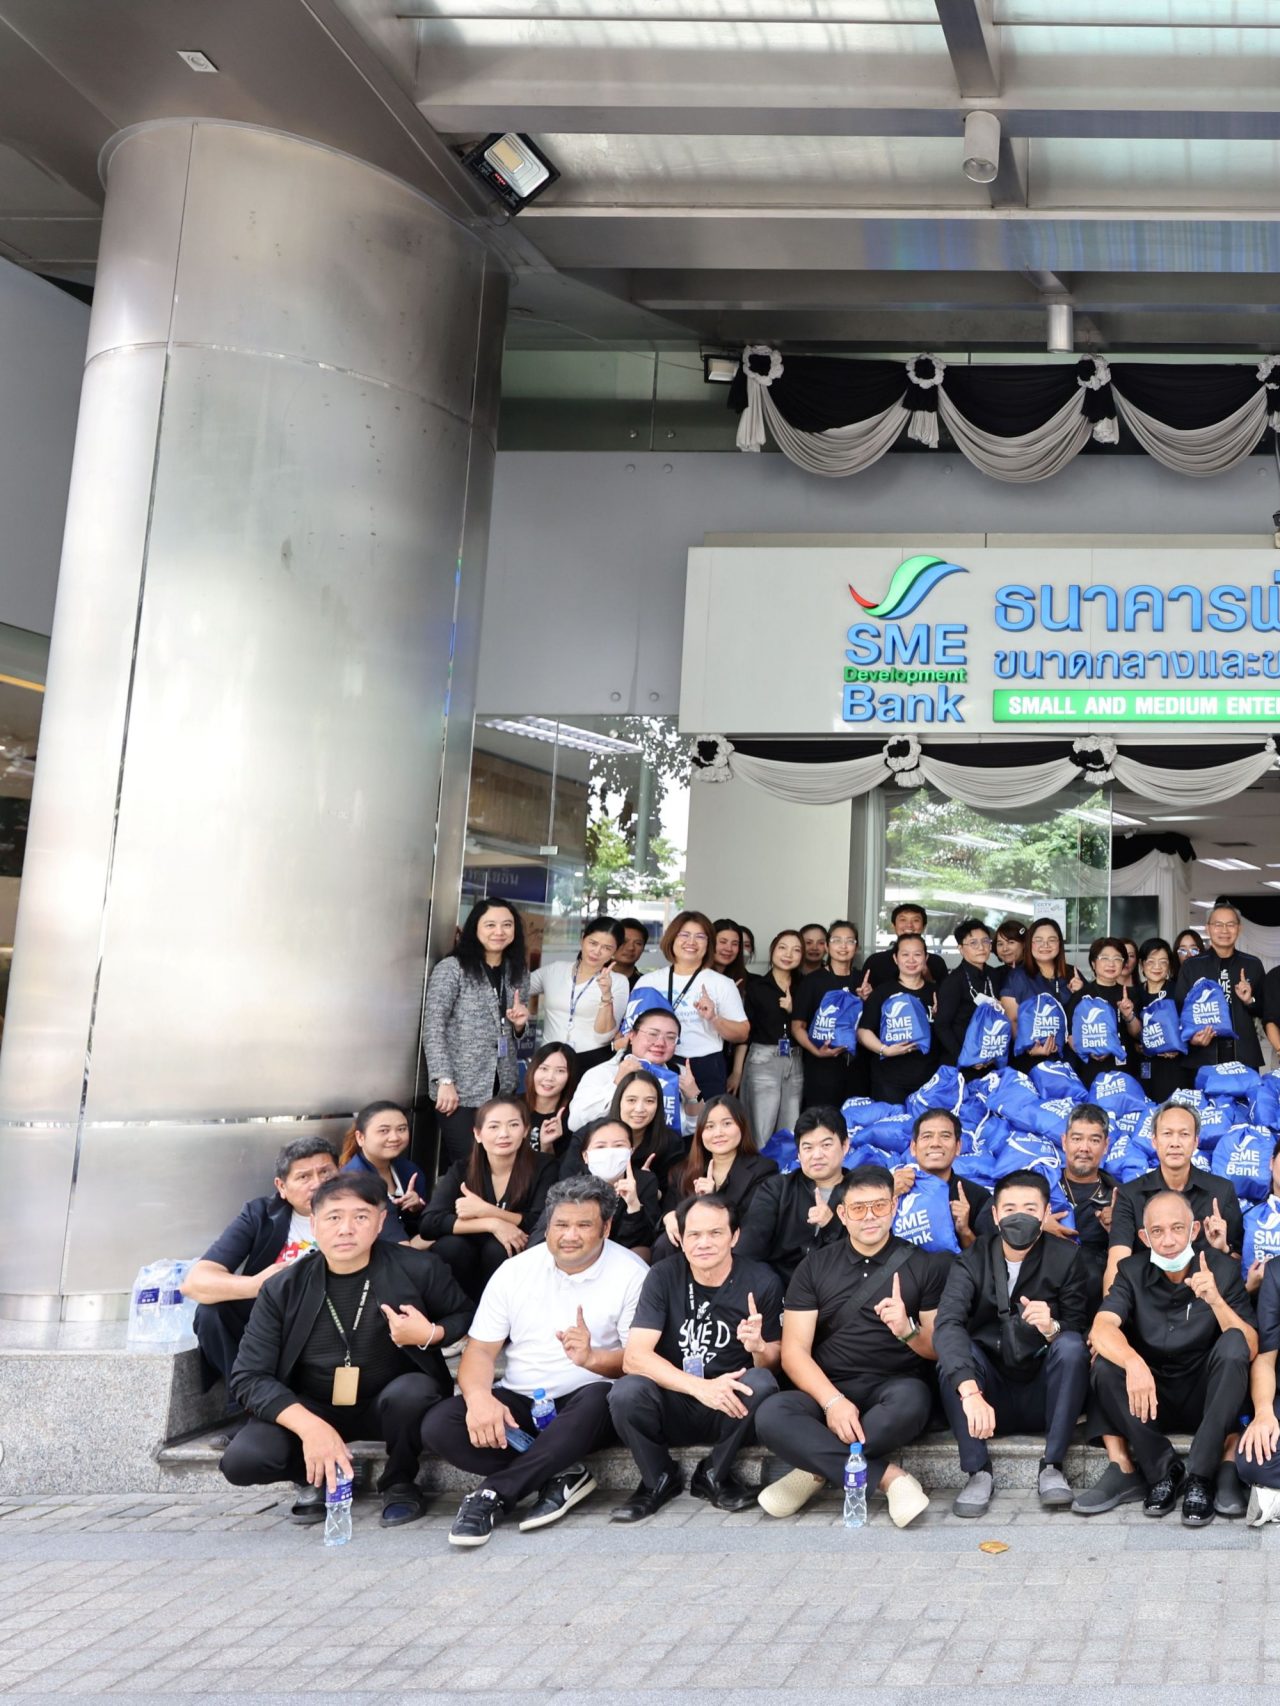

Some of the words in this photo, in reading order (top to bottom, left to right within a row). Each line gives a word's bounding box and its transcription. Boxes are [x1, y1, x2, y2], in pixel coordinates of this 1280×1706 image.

[845, 623, 968, 666] SME
[843, 666, 968, 684] Development
[841, 684, 966, 723] Bank
[1008, 696, 1077, 715] SMALL
[1084, 696, 1127, 715] AND
[1135, 696, 1218, 716] MEDIUM
[1192, 1001, 1220, 1014] SME
[815, 1016, 837, 1028] SME
[886, 1016, 912, 1029] SME
[1035, 1016, 1060, 1027] SME
[1193, 1014, 1221, 1025] Bank
[812, 1029, 835, 1041] Bank
[1082, 1023, 1107, 1035] SME
[1142, 1022, 1163, 1037] SME
[886, 1030, 913, 1042] Bank
[982, 1034, 1008, 1046] SME
[1143, 1035, 1166, 1048] Bank
[1082, 1038, 1108, 1048] Bank
[1230, 1150, 1260, 1162] SME
[1226, 1165, 1259, 1177] Bank
[895, 1209, 930, 1233] SME
[715, 1320, 731, 1348] D
